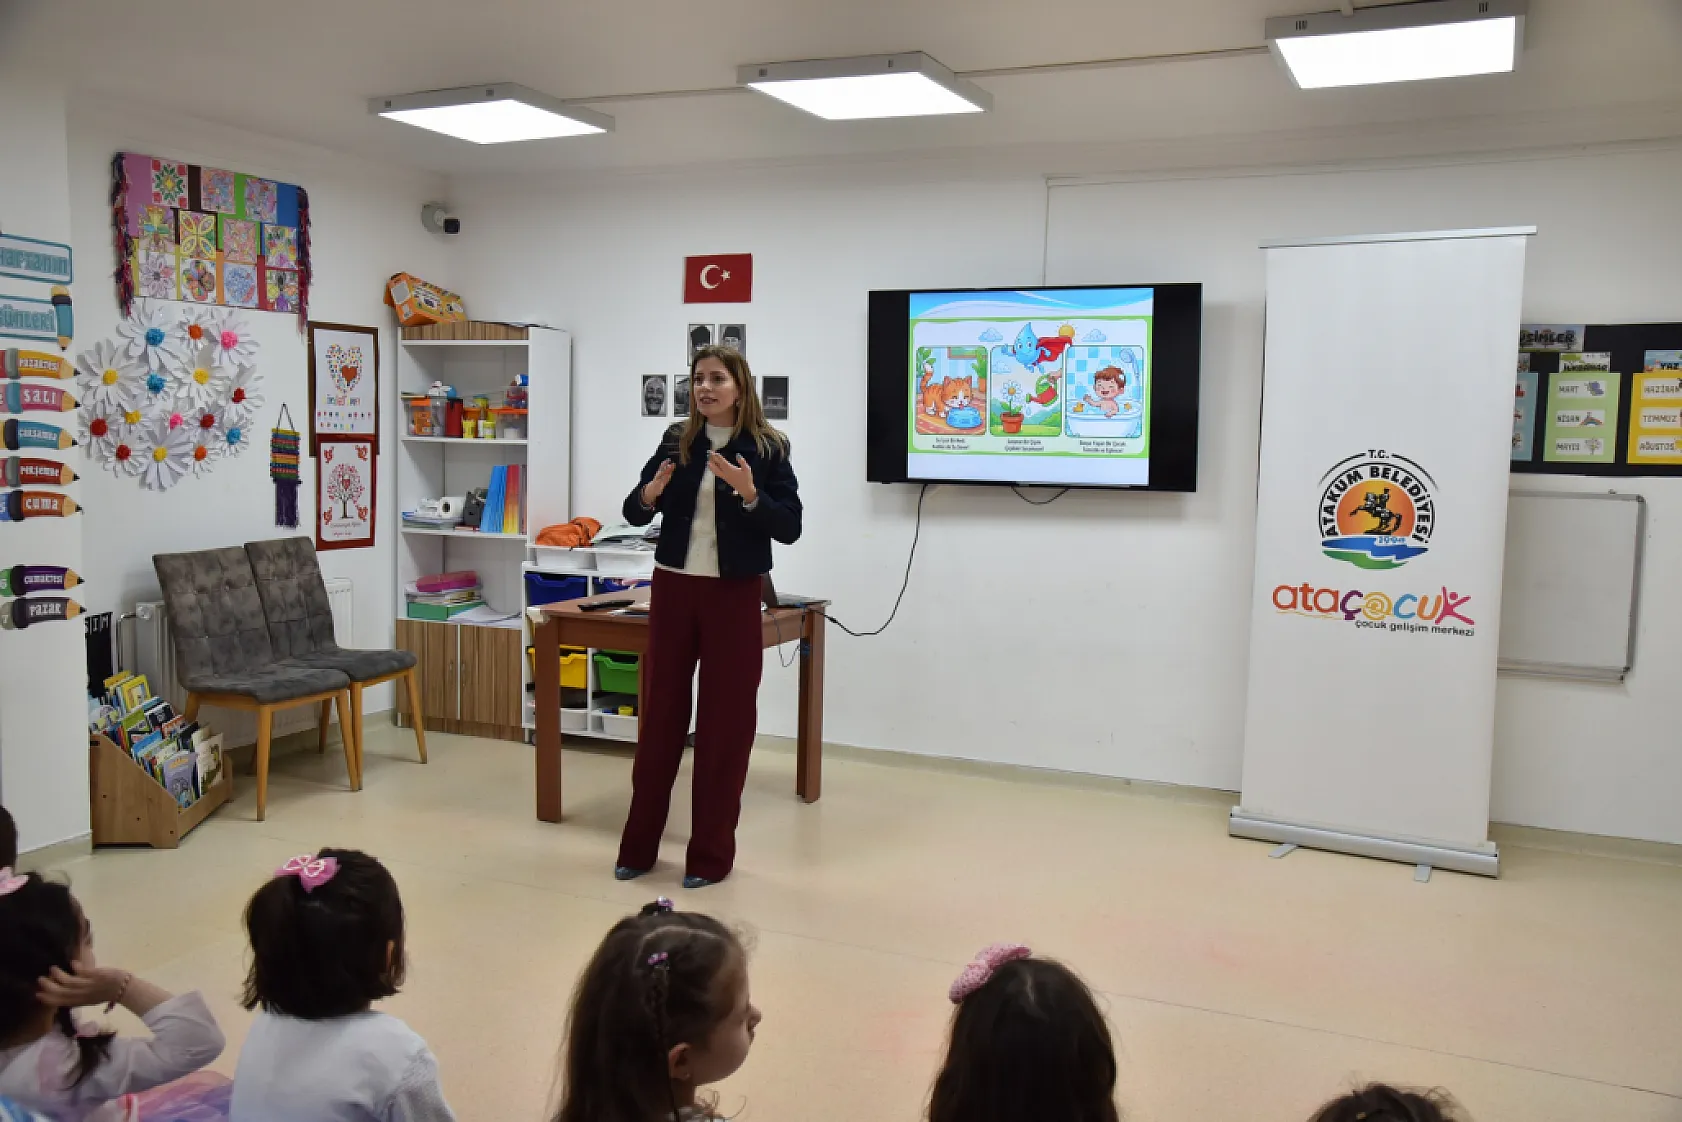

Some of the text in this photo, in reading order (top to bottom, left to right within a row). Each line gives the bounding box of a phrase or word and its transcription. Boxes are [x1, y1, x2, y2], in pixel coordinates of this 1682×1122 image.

[1559, 385, 1580, 394] MART
[1368, 449, 1390, 459] T.C.
[1321, 465, 1431, 544] ATAKUM BELEDİYESİ
[1355, 619, 1475, 637] çocuk gelişim merkezi
